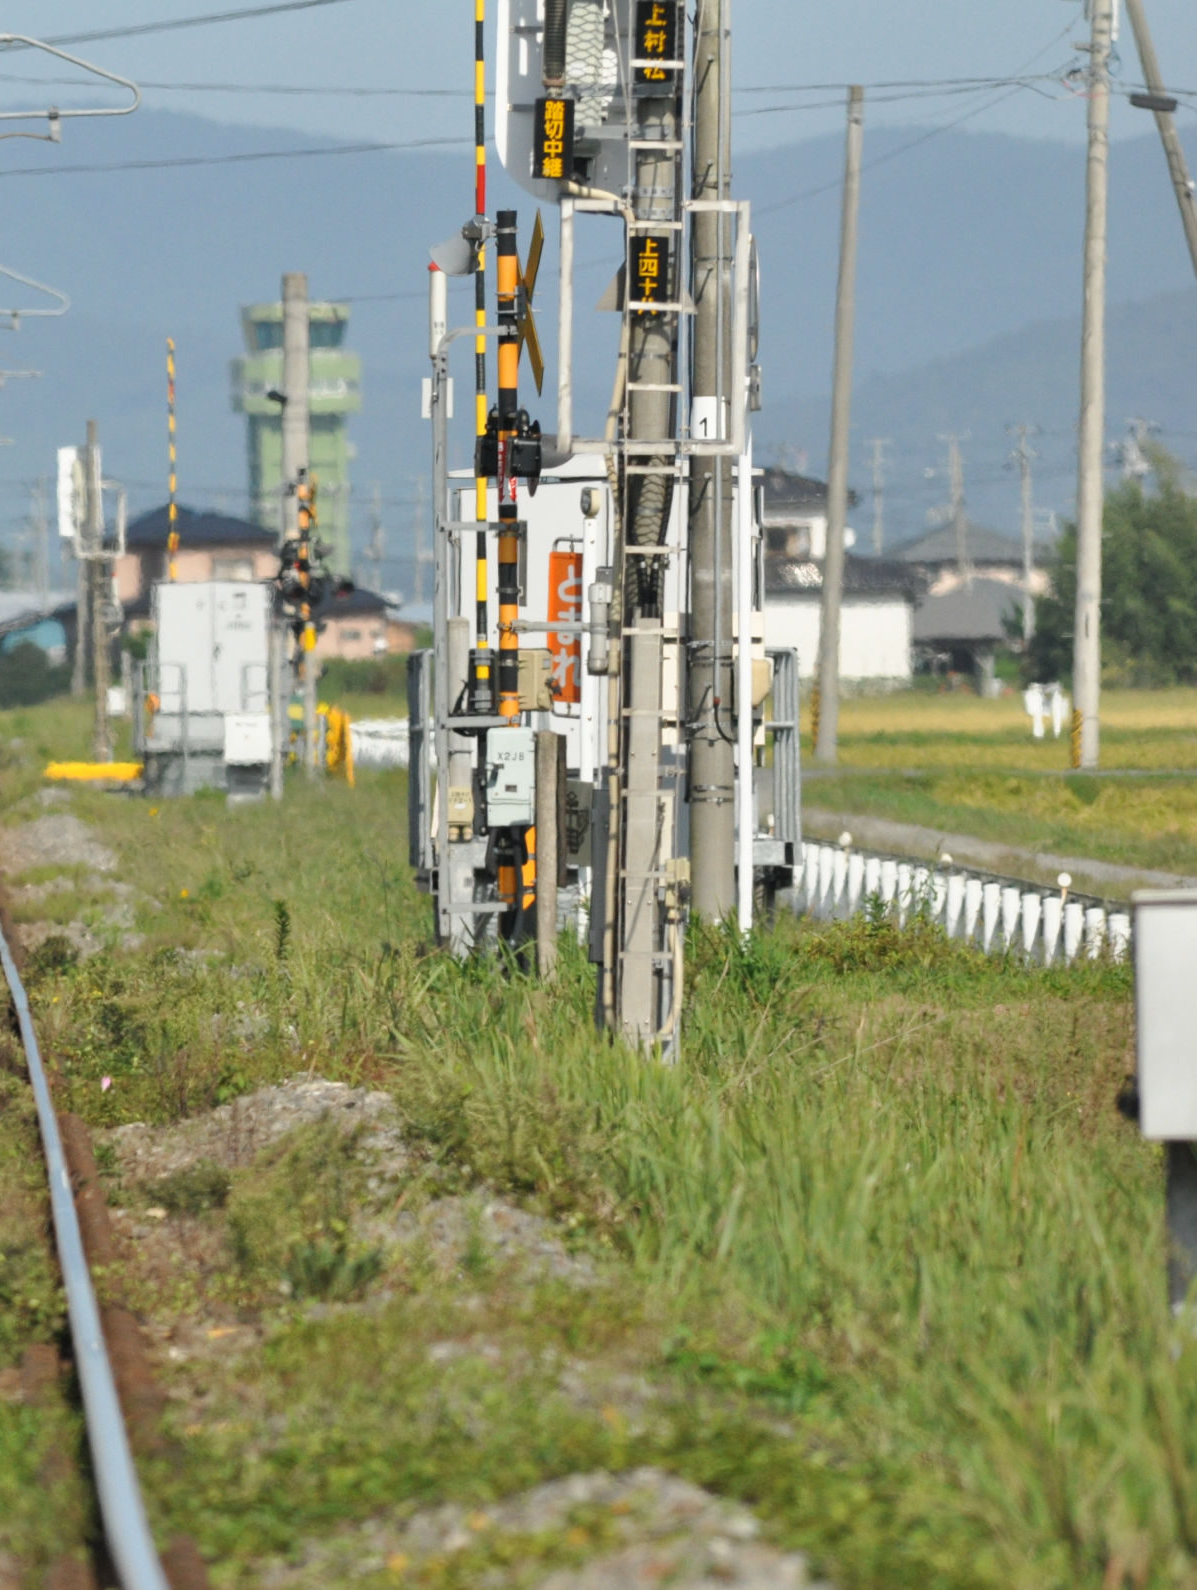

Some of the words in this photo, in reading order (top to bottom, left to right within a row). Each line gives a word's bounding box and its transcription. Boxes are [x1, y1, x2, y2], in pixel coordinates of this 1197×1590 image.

[542, 100, 564, 177] 踏切中継
[699, 417, 707, 437] 1
